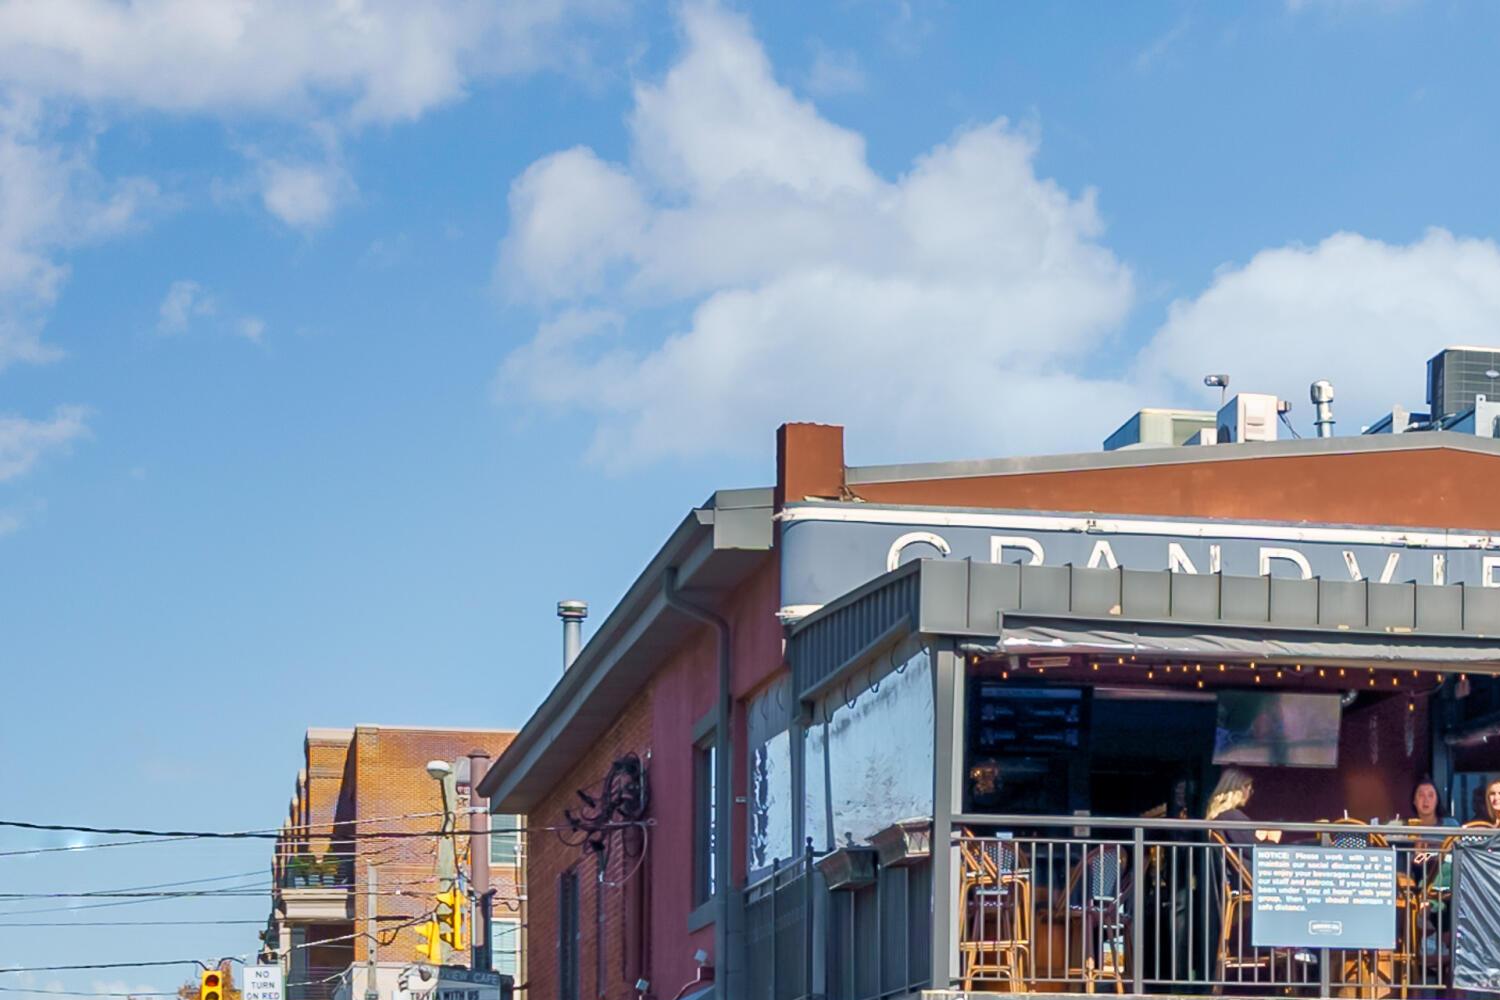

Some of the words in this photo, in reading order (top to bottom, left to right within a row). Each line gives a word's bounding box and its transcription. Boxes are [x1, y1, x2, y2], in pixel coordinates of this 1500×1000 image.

[1331, 862, 1361, 870] distance
[1273, 869, 1293, 878] enjoy
[1312, 870, 1350, 879] beverages
[1272, 877, 1289, 885] staff
[1346, 880, 1360, 888] you
[1325, 896, 1349, 904] should
[255, 970, 270, 979] NO
[251, 981, 275, 990] TURN
[246, 992, 259, 1000] ON
[261, 992, 280, 1000] RED
[467, 990, 479, 1000] US
